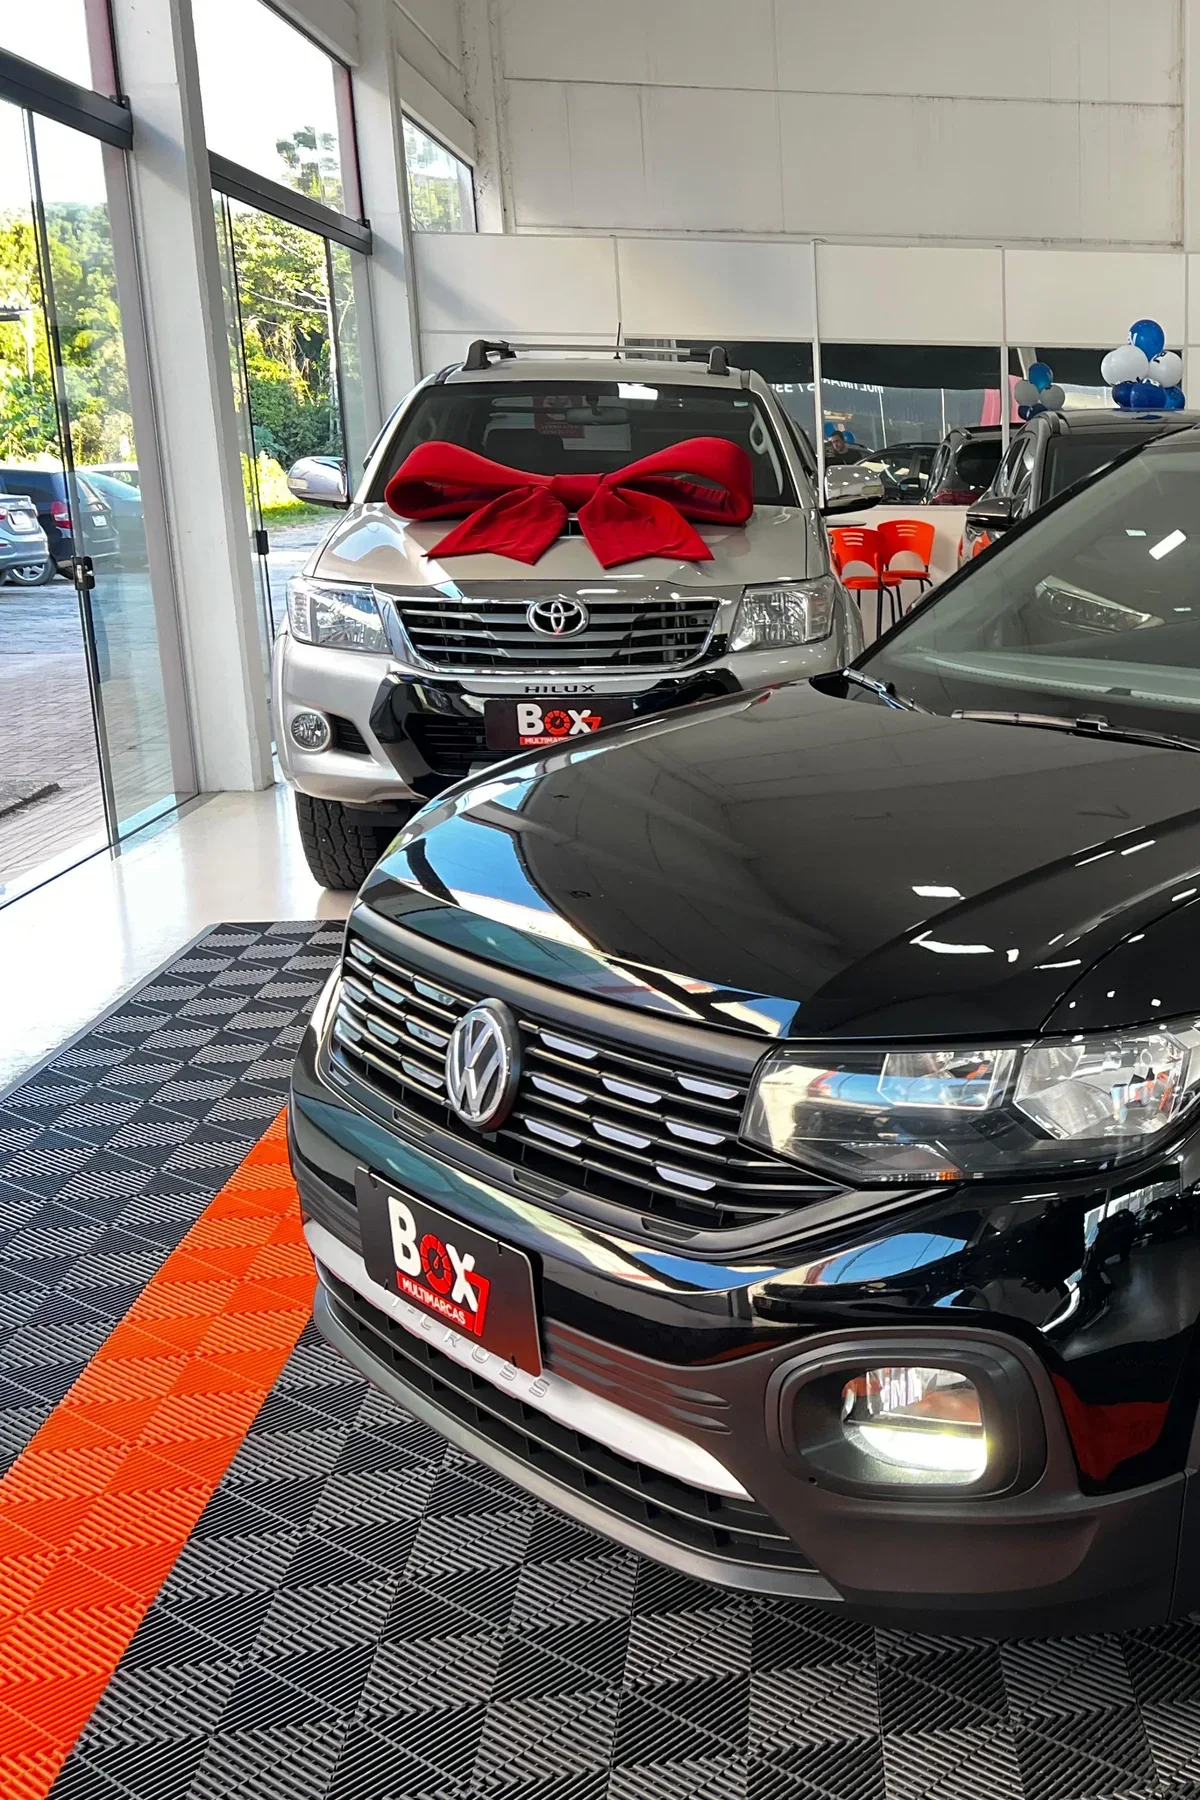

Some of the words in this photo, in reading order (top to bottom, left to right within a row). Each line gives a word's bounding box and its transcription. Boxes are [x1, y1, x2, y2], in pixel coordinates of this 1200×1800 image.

[525, 685, 596, 694] HILUX
[517, 703, 592, 735] BOX
[524, 737, 568, 745] MULTIMA
[388, 1196, 478, 1312] BOX
[402, 1277, 467, 1325] MULTIMARCAS
